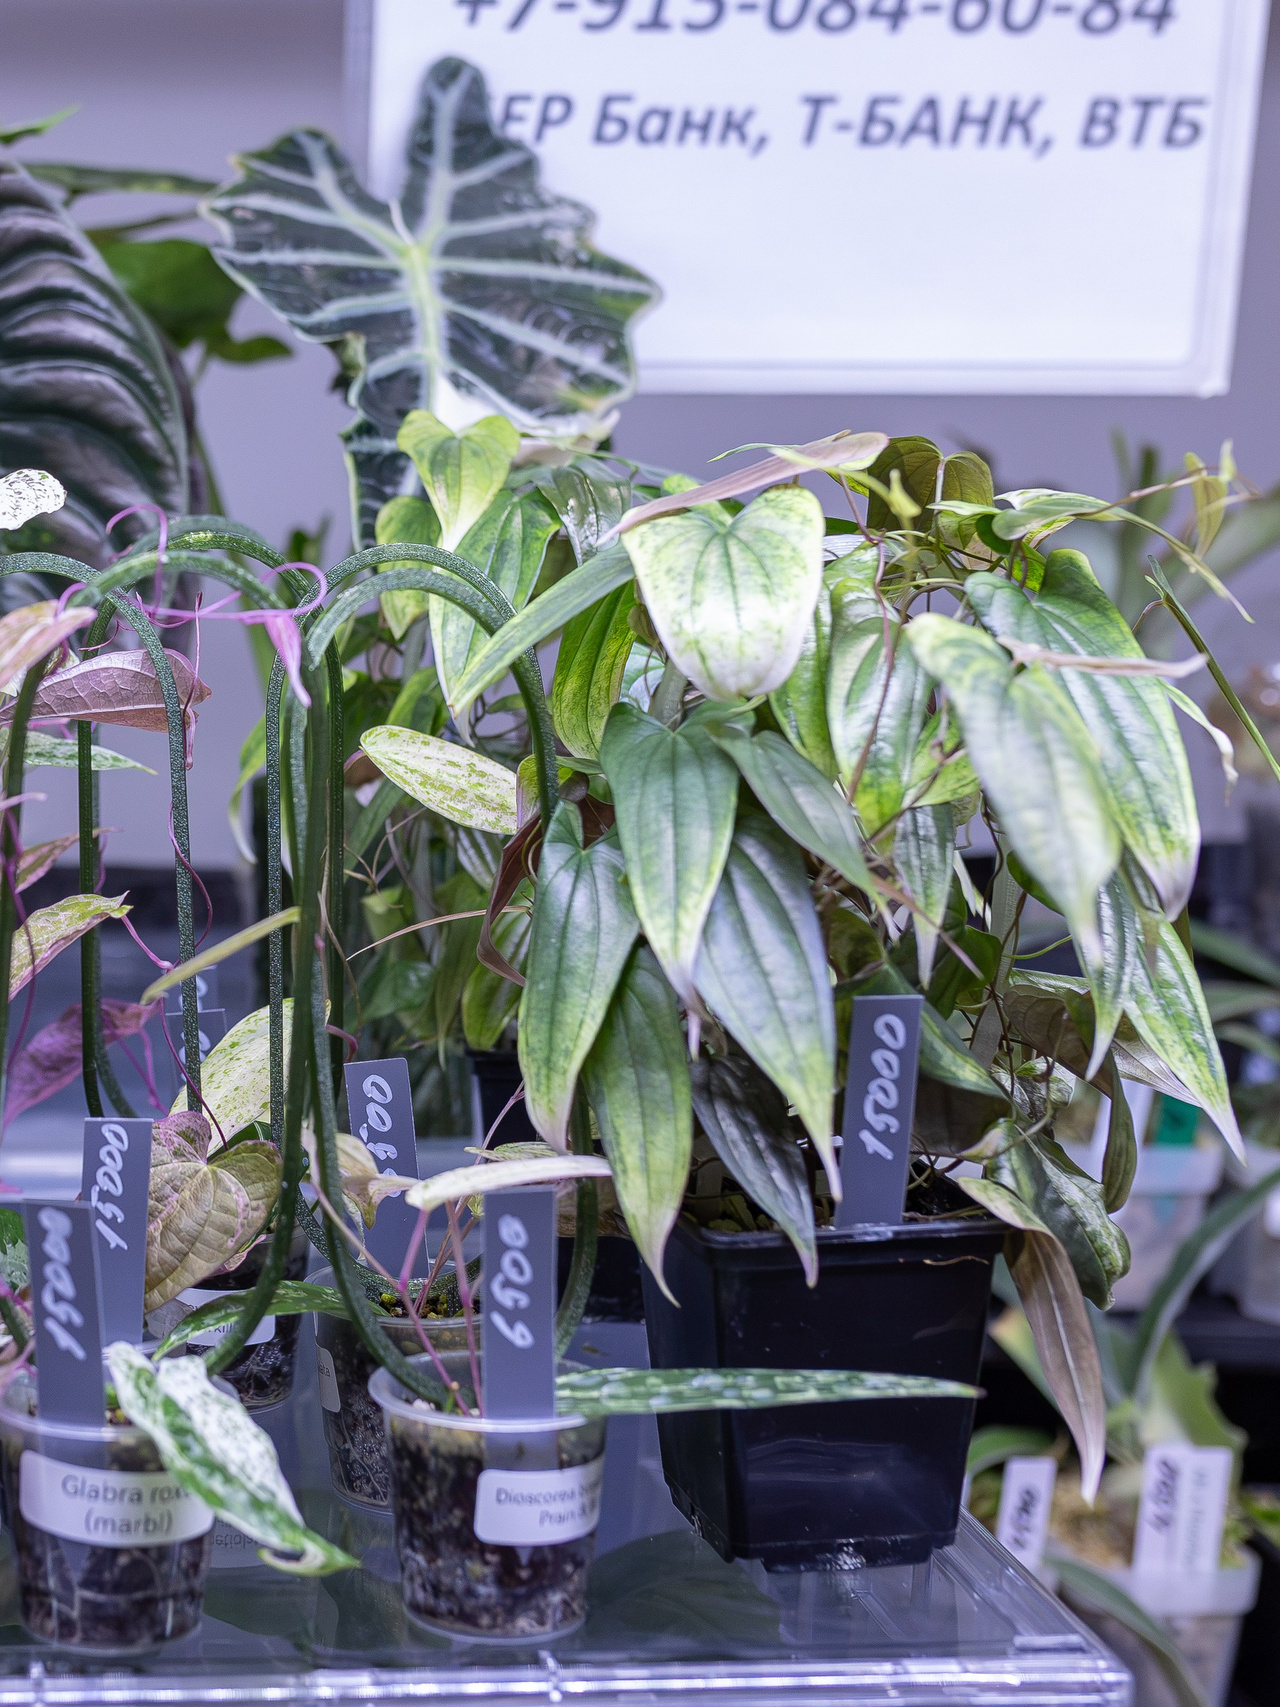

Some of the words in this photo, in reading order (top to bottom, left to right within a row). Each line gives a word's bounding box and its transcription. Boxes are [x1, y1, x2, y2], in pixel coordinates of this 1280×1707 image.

[593, 93, 767, 155] Банк,
[800, 93, 1053, 158] Т-БАНК,
[1081, 94, 1210, 149] ВТБ
[858, 1012, 907, 1162] 15000
[90, 1123, 130, 1251] 15000
[36, 1205, 89, 1362] 15000
[489, 1212, 536, 1350] 6500
[61, 1473, 143, 1504] Glabra
